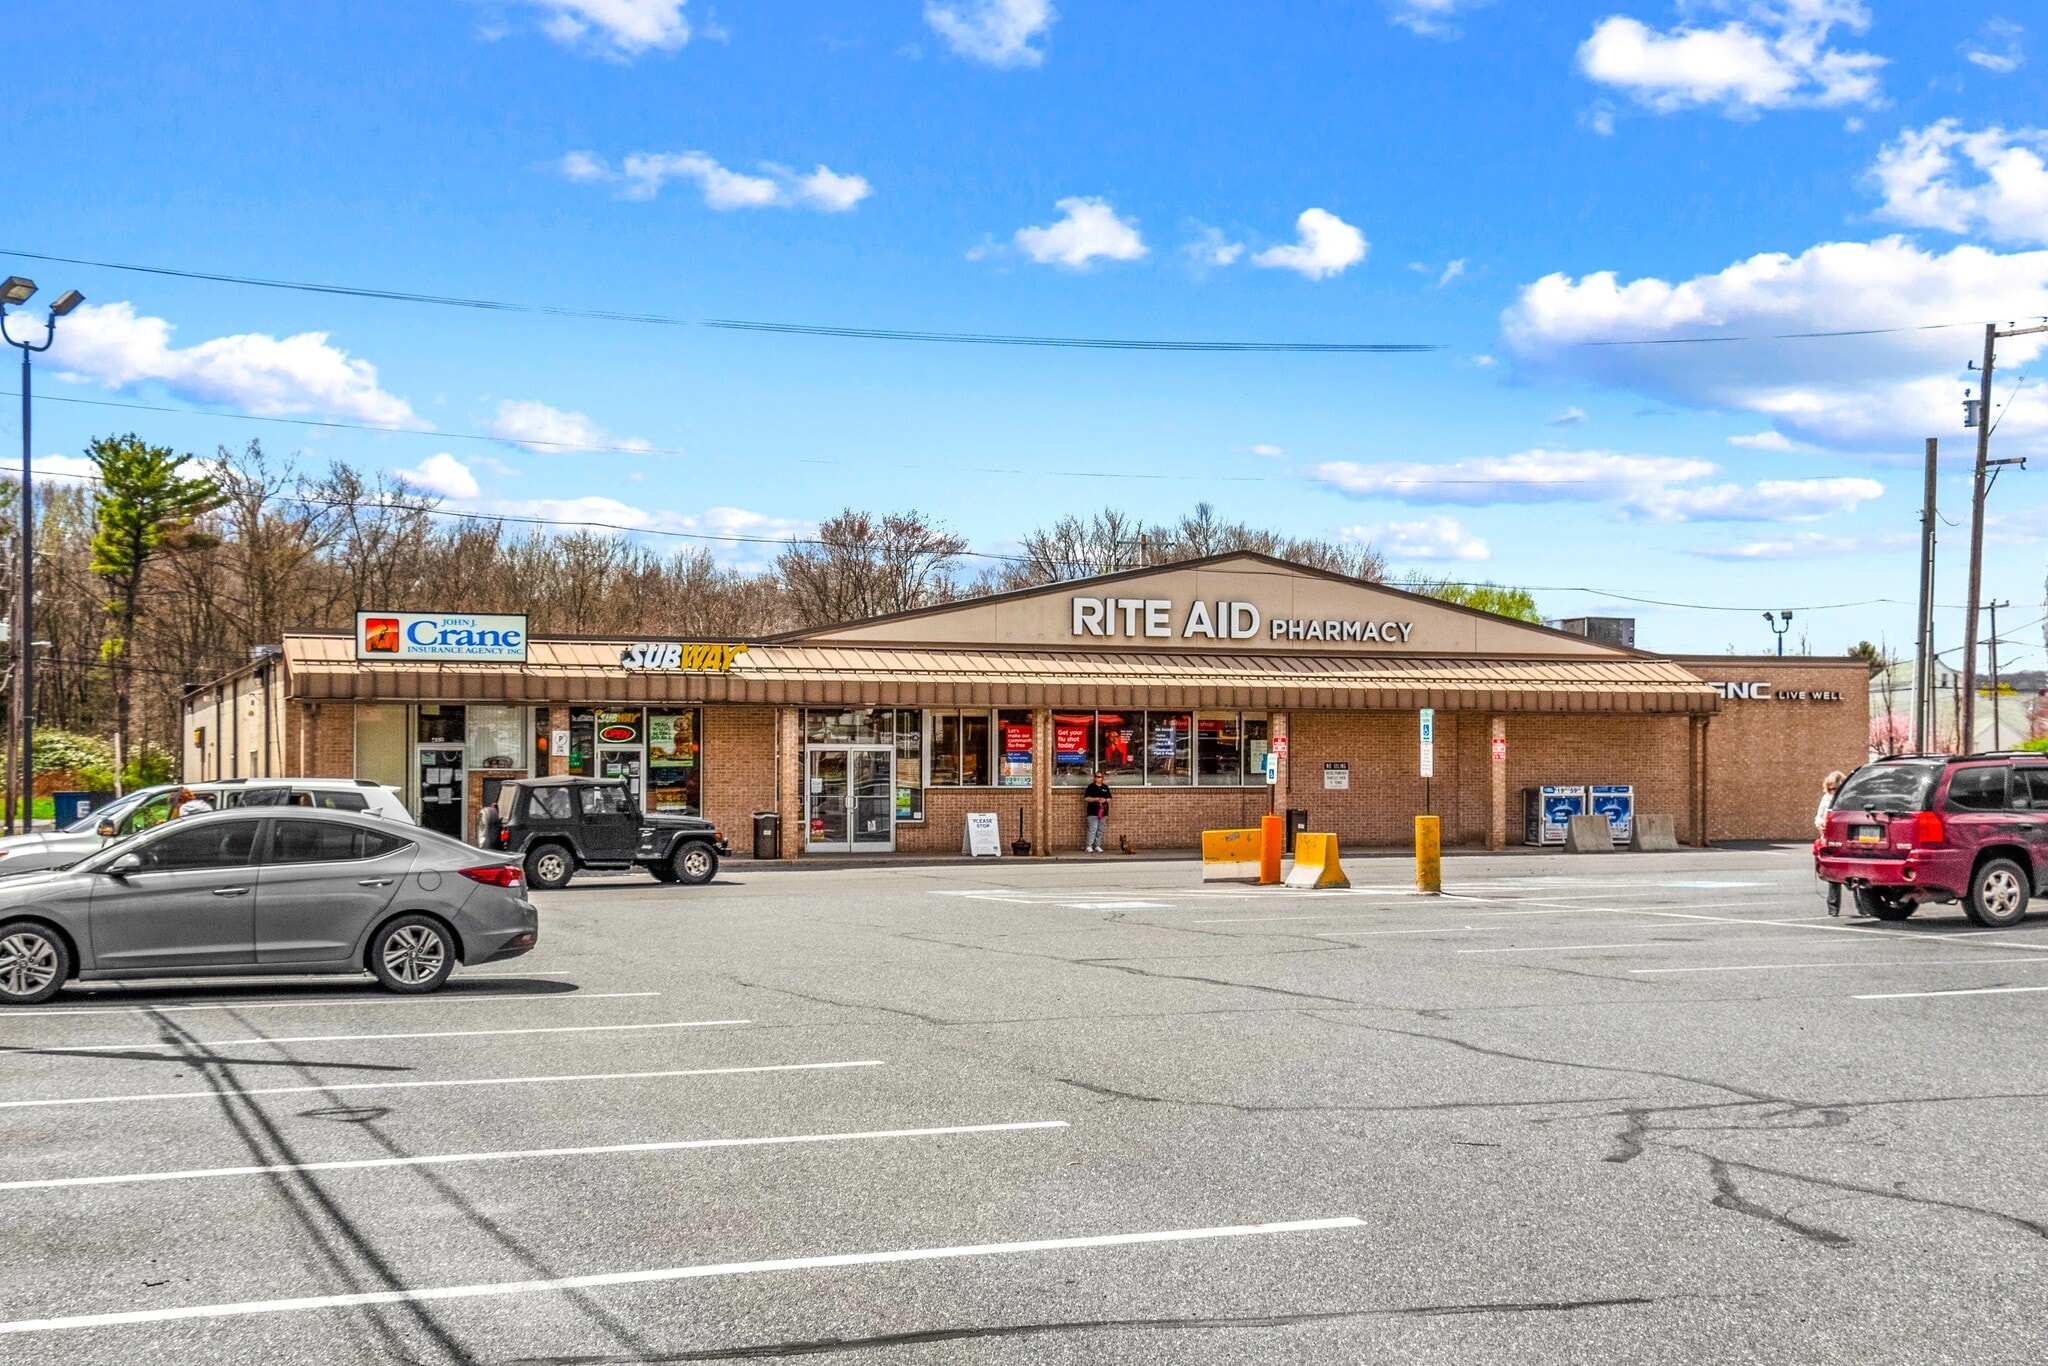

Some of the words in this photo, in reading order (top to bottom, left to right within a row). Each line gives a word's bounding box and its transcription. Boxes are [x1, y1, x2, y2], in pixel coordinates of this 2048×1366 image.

[441, 618, 468, 627] JOHN
[470, 619, 477, 627] J.
[1072, 597, 1172, 637] RITE
[1183, 601, 1260, 639] AID
[1270, 619, 1414, 642] PHARMACY
[407, 620, 521, 647] Crane
[407, 646, 464, 654] INSURANCE
[465, 647, 504, 655] AGENCY
[622, 643, 749, 671] SUBWAY
[1778, 691, 1806, 700] LIVE
[1811, 691, 1845, 700] WELL
[598, 712, 640, 723] SUBWAY
[603, 729, 631, 739] OPEN
